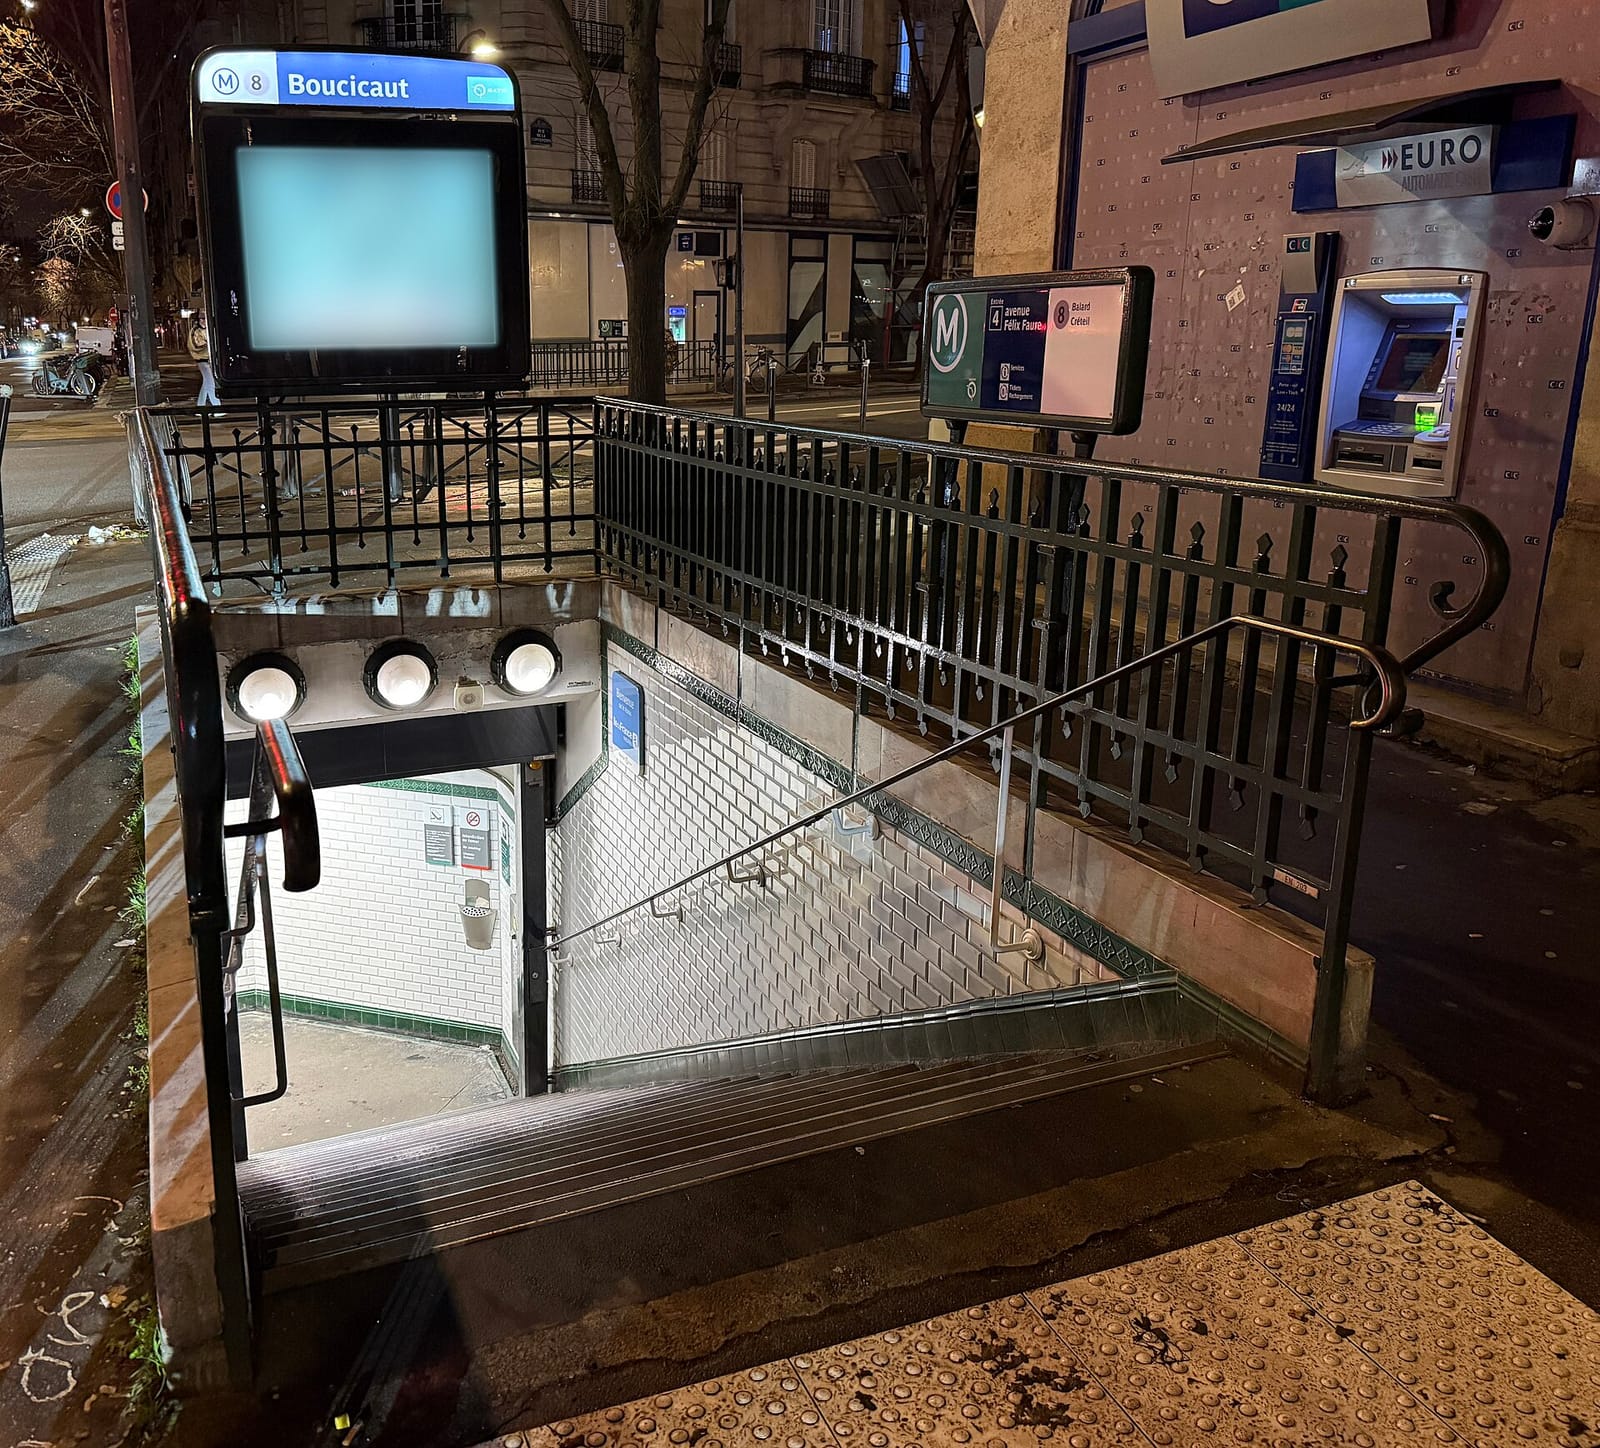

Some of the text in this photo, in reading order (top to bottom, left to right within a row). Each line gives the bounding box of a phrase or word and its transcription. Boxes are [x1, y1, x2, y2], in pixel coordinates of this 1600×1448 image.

[218, 74, 233, 89] M
[251, 75, 262, 90] 8
[288, 73, 409, 99] Boucicaut
[1401, 134, 1482, 171] EURO
[1288, 238, 1311, 250] CIC
[1004, 306, 1030, 317] avenue
[1071, 302, 1091, 311] Balard
[992, 310, 1000, 327] 4
[1058, 306, 1065, 324] 8
[1070, 317, 1090, 326] Créteil
[936, 308, 959, 353] M
[1004, 319, 1042, 331] Félix Faure
[1276, 403, 1295, 412] 24/24
